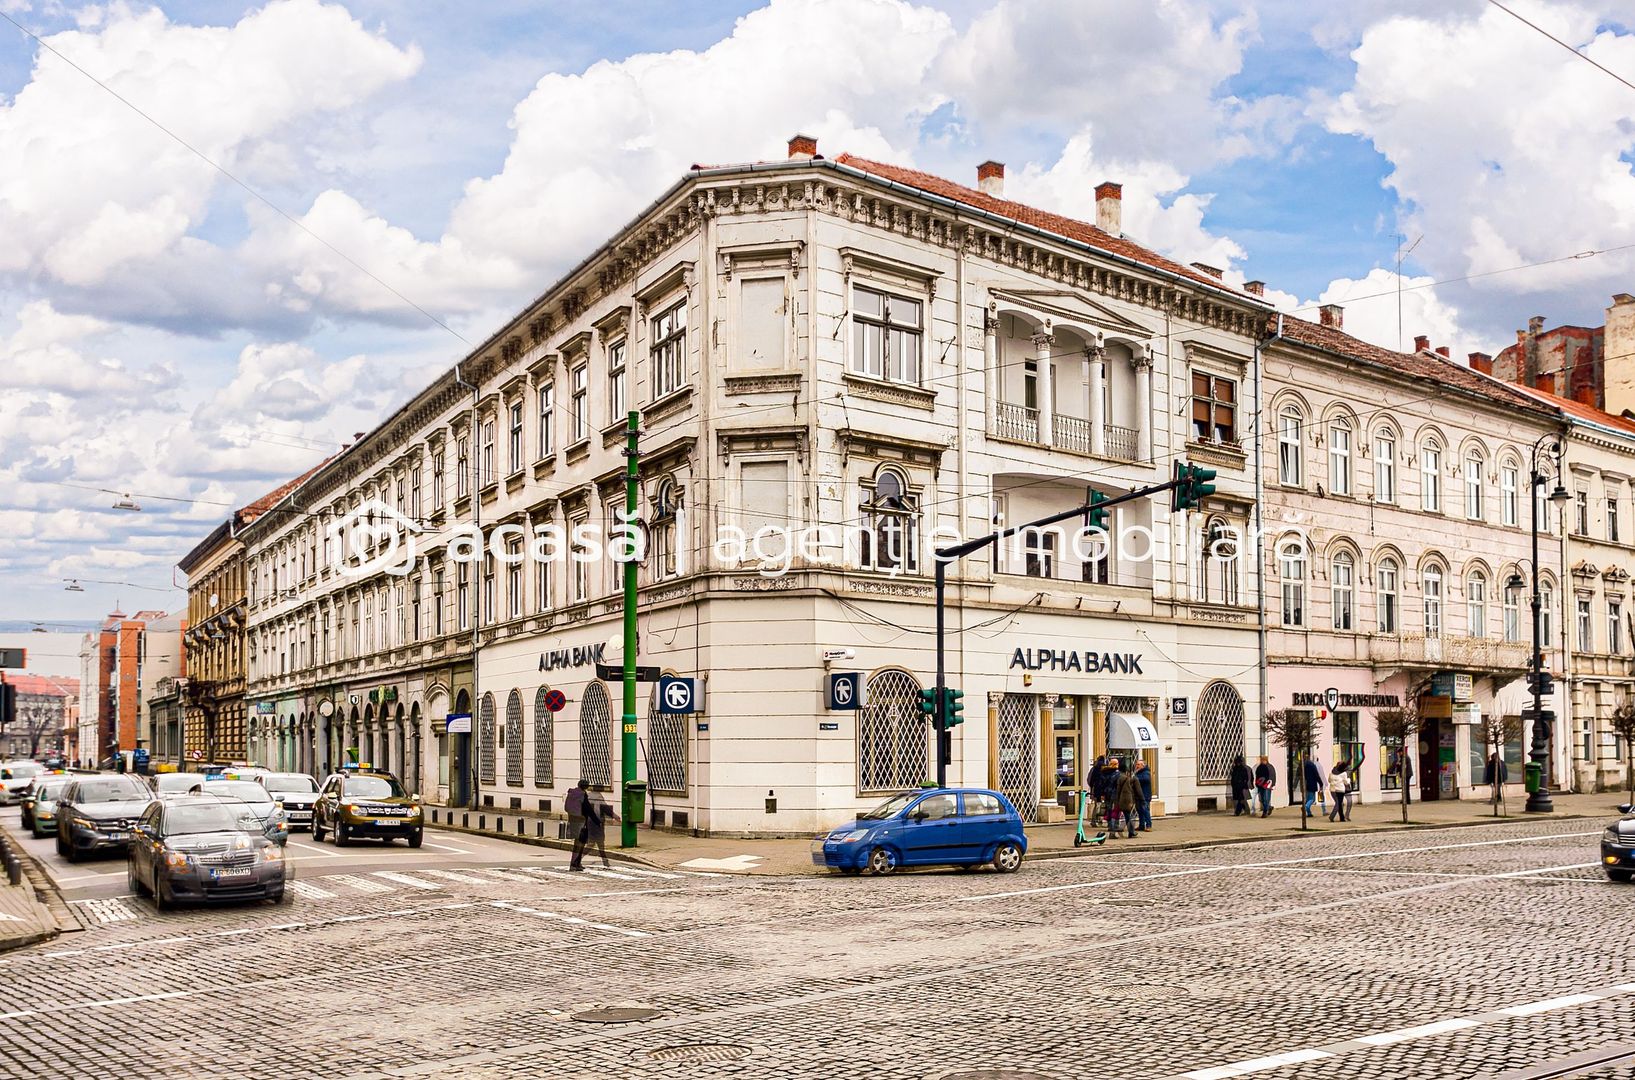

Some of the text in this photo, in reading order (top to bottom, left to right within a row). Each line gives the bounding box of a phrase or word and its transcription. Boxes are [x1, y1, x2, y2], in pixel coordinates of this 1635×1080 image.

[538, 642, 607, 672] ALPHA BANK
[1009, 647, 1144, 675] ALPHA BANK
[1292, 692, 1325, 706] BANCA
[1339, 693, 1400, 707] TRANSILVANIA
